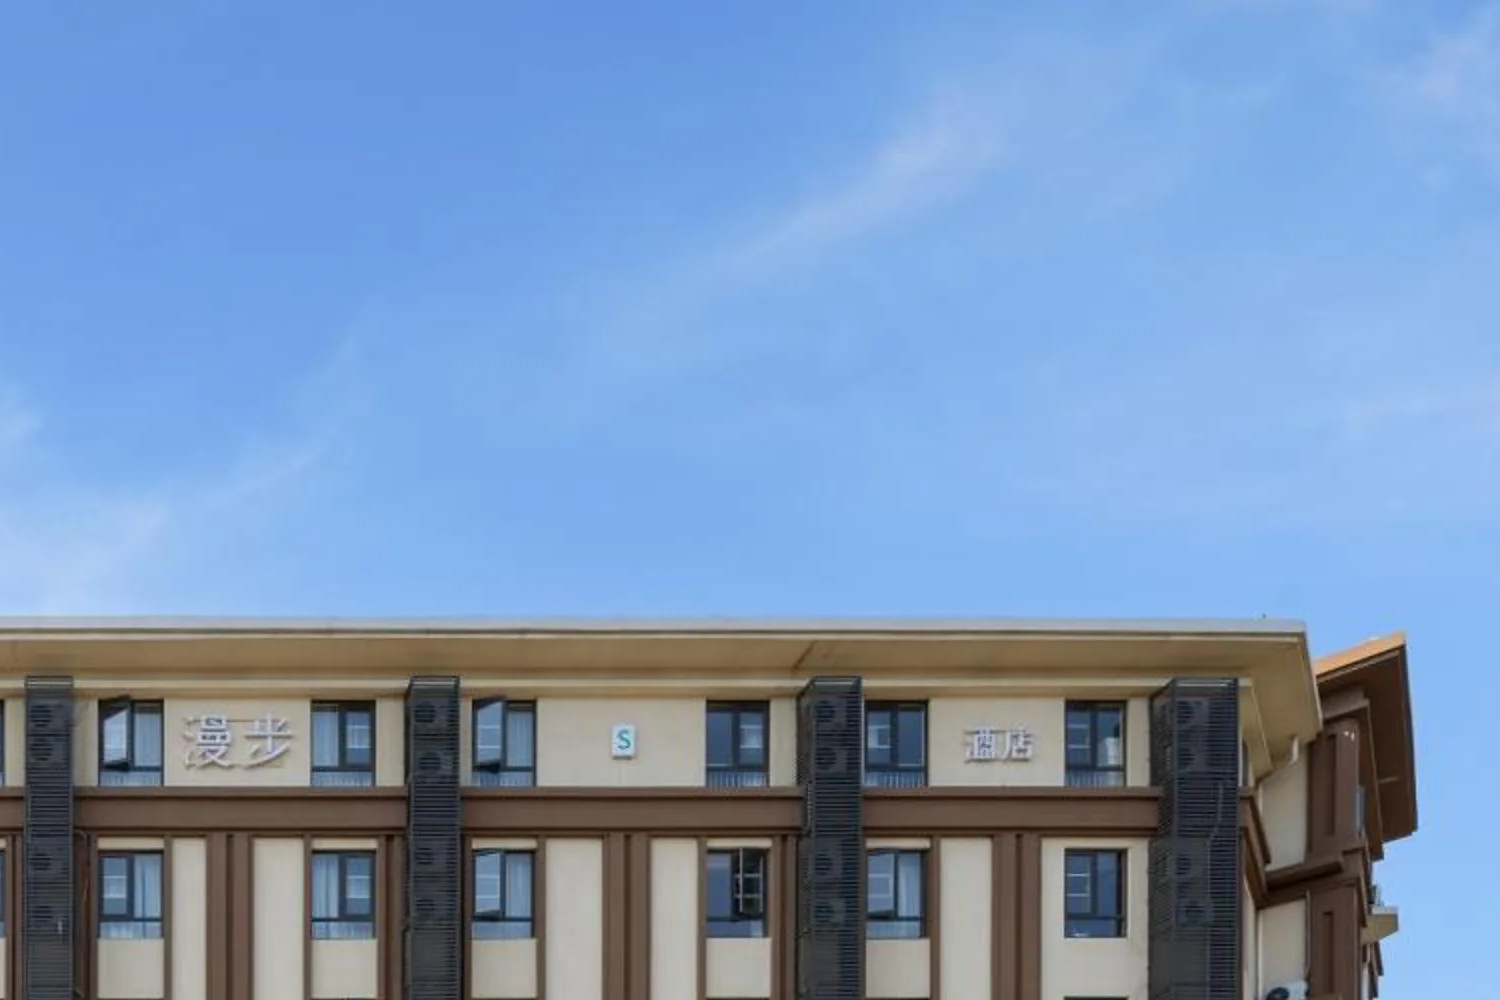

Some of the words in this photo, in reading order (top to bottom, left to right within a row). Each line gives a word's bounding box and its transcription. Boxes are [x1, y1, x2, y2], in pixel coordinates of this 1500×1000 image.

[182, 714, 296, 770] 漫步
[617, 728, 632, 750] S
[963, 724, 1036, 763] 酒店
